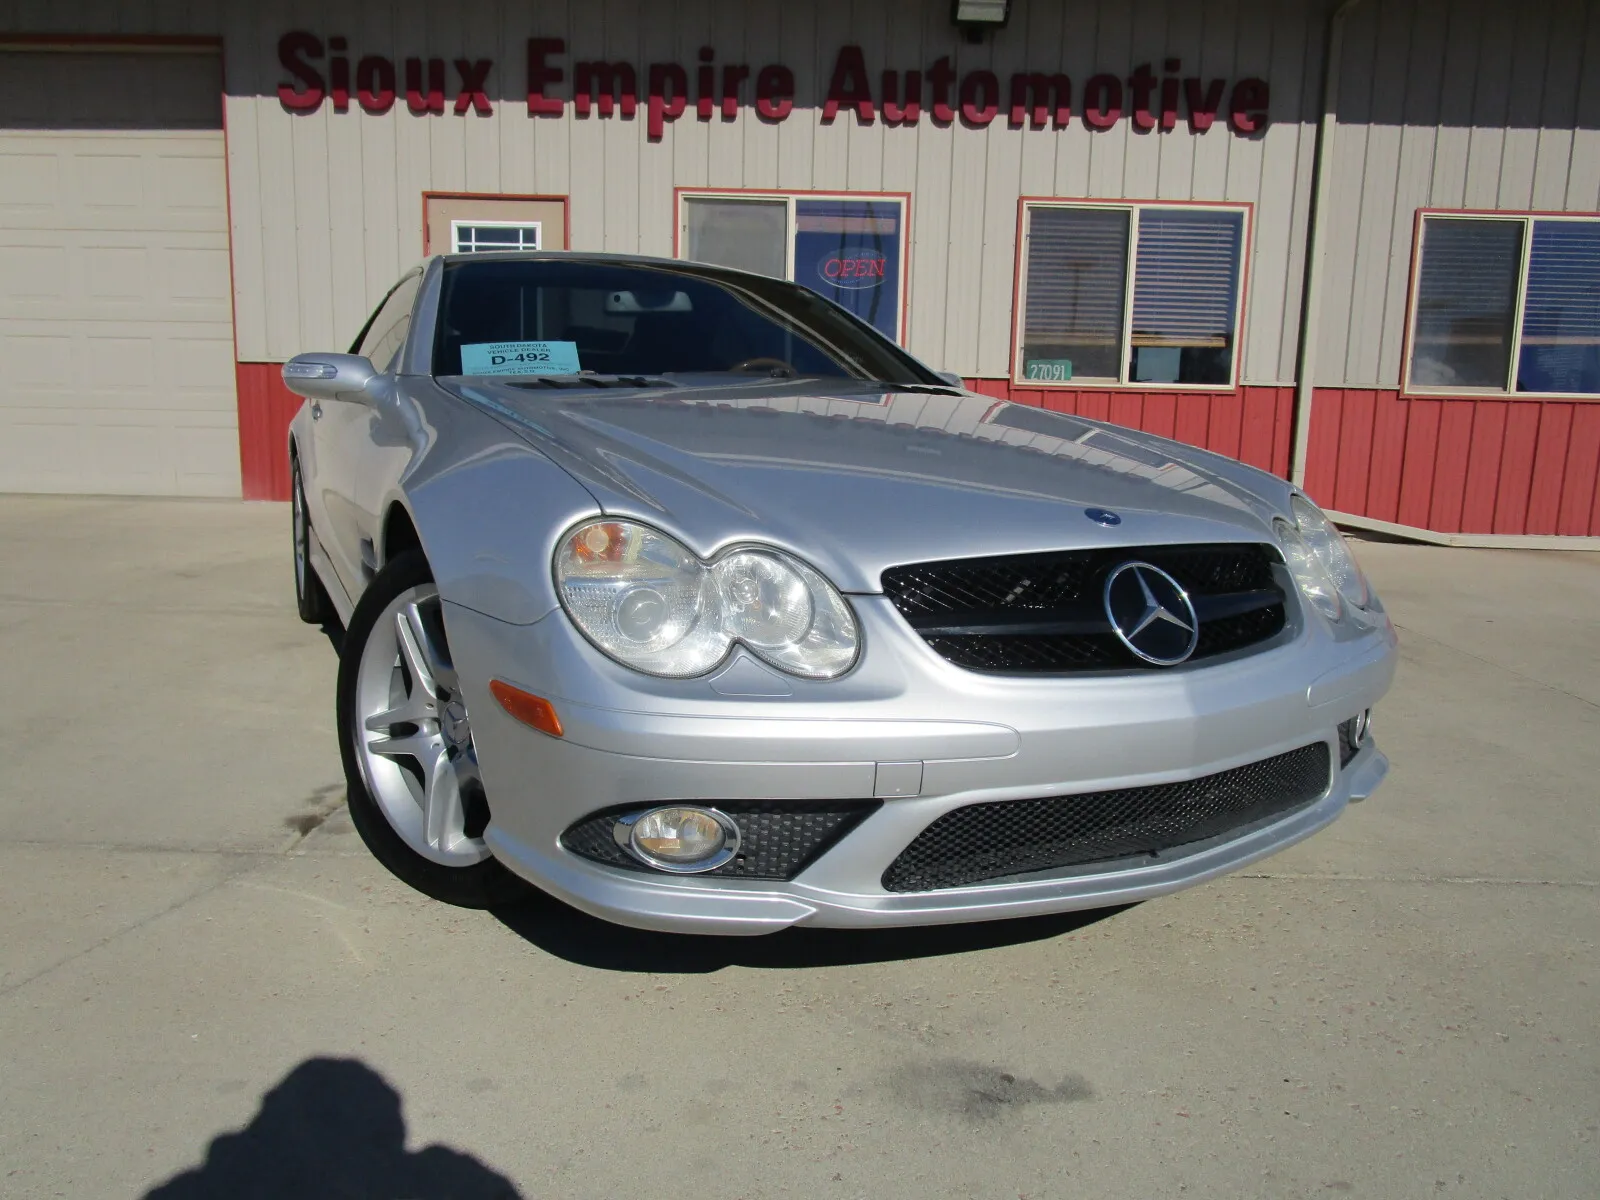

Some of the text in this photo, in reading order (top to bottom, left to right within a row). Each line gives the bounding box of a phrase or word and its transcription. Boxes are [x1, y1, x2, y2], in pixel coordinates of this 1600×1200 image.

[277, 30, 1271, 142] Sioux Empire Automotive
[824, 258, 886, 277] OPEN
[491, 352, 550, 366] D-492
[1030, 364, 1065, 380] 27091
